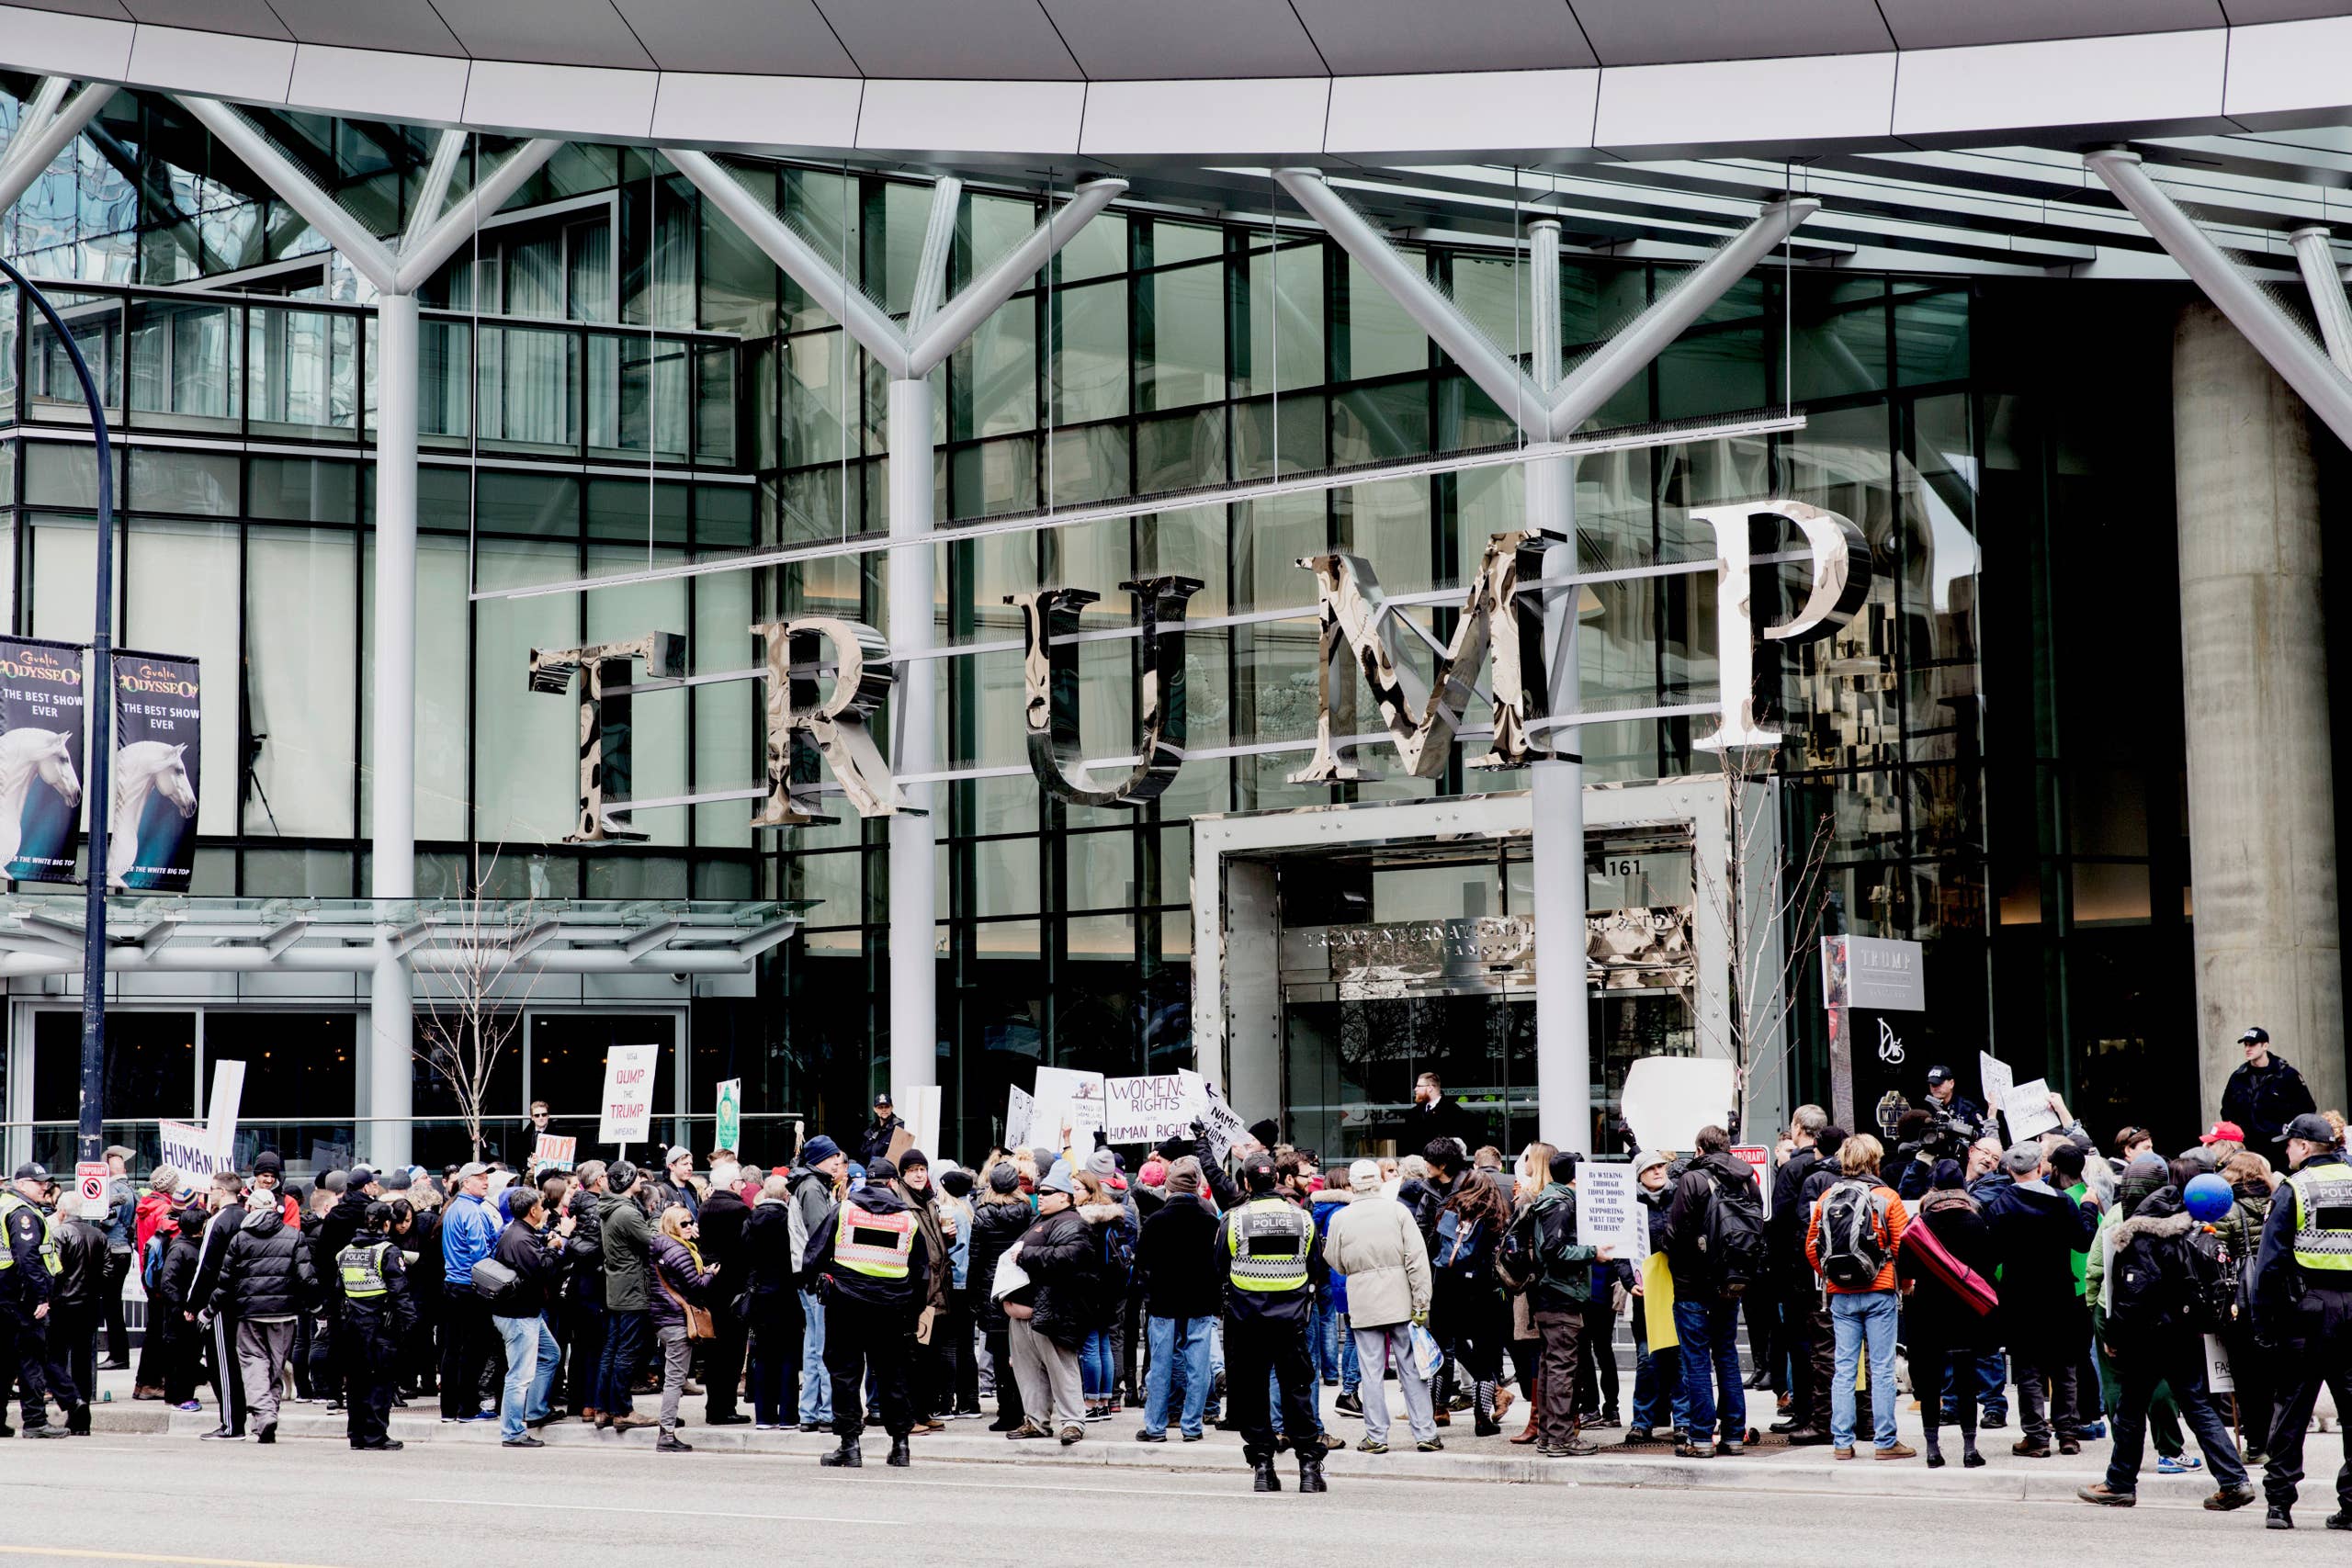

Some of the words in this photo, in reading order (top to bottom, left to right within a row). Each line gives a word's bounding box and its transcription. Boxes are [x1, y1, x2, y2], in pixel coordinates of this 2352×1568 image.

[528, 499, 1871, 845] TRUMP
[4, 688, 22, 700] THE
[25, 691, 50, 704] BEST
[53, 695, 85, 706] SHOW
[32, 705, 58, 717] EVER
[123, 703, 142, 714] THE
[144, 705, 166, 716] BEST
[169, 708, 200, 719] SHOW
[151, 718, 175, 730] EVER
[32, 857, 52, 865] WHITE
[1610, 859, 1640, 876] 161
[135, 865, 147, 874] THE
[147, 866, 167, 874] WHITE
[1860, 948, 1911, 969] TRUMP
[616, 1068, 645, 1084] DUMP
[624, 1090, 634, 1099] THE
[610, 1103, 644, 1119] TRUMP
[1131, 1097, 1180, 1112] RIGHTS
[1210, 1106, 1239, 1132] NAME
[1110, 1125, 1148, 1140] HUMAN
[163, 1140, 233, 1176] HUMANY
[1732, 1151, 1765, 1163] MPORARY
[79, 1166, 107, 1176] TEMPORARY
[2320, 1188, 2352, 1198] POLI
[853, 1210, 871, 1219] FIRE
[873, 1213, 905, 1224] RESCUE
[1252, 1219, 1294, 1228] POLICE
[345, 1253, 369, 1261] POLICE
